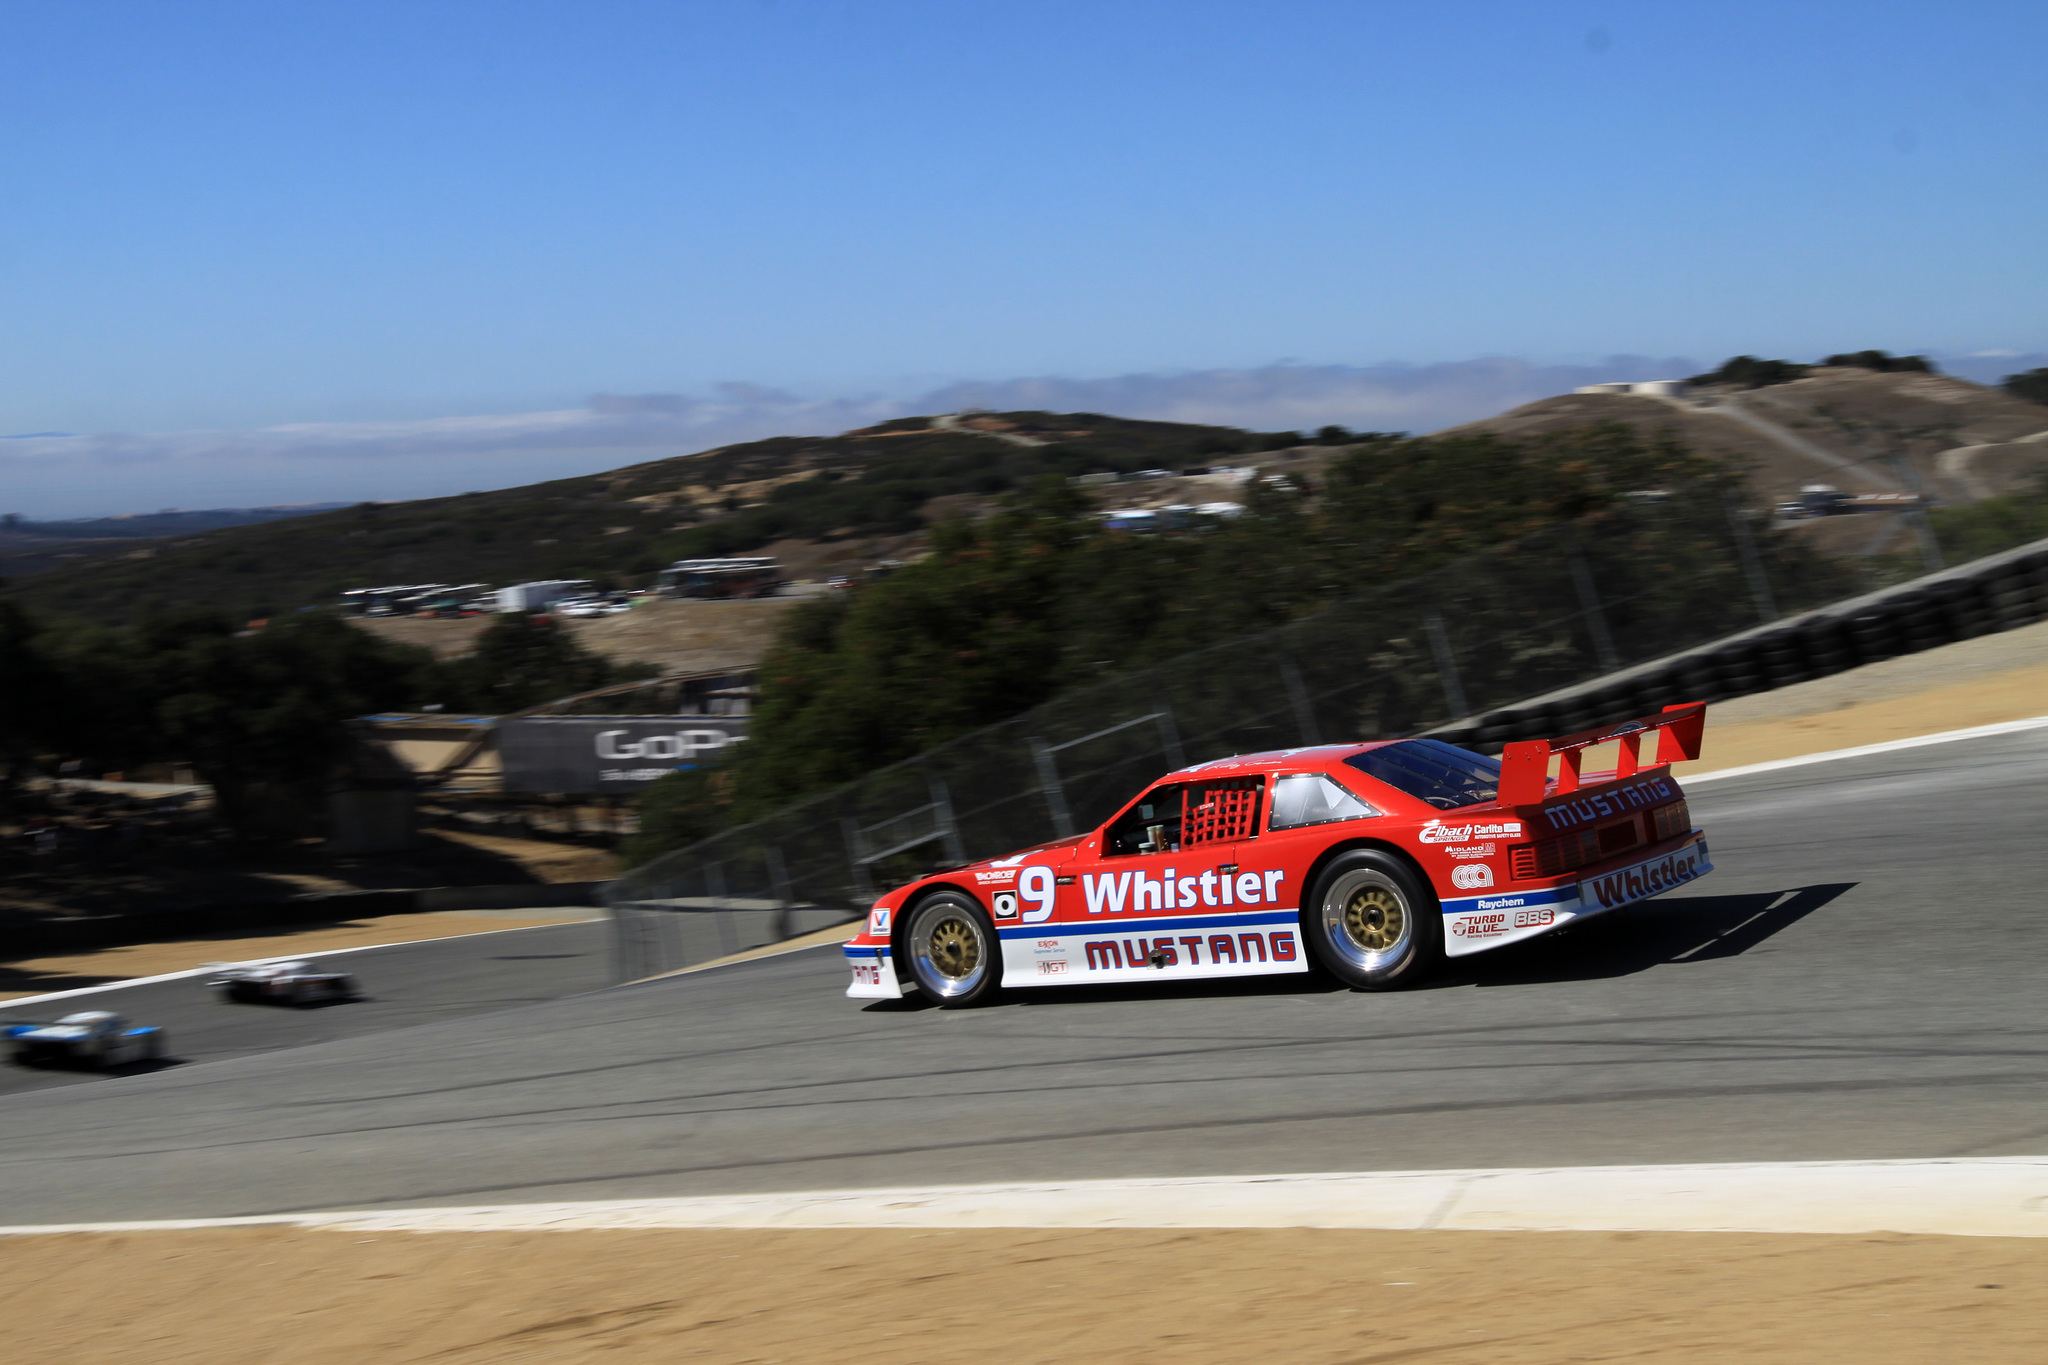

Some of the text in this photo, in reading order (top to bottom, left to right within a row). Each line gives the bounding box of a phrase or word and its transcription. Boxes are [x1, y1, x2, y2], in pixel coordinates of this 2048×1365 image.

[1544, 776, 1672, 830] MUSTANG
[1474, 824, 1503, 834] Carlite
[1081, 868, 1284, 914] Whistler
[1593, 855, 1699, 908] Whistler
[1018, 865, 1056, 924] 9
[1478, 898, 1525, 910] Raychem
[1461, 914, 1505, 925] TURBO
[1514, 909, 1555, 928] BBS
[1468, 924, 1509, 934] BLUE
[1037, 940, 1059, 948] EXXON
[1085, 931, 1298, 970] MUSTANG
